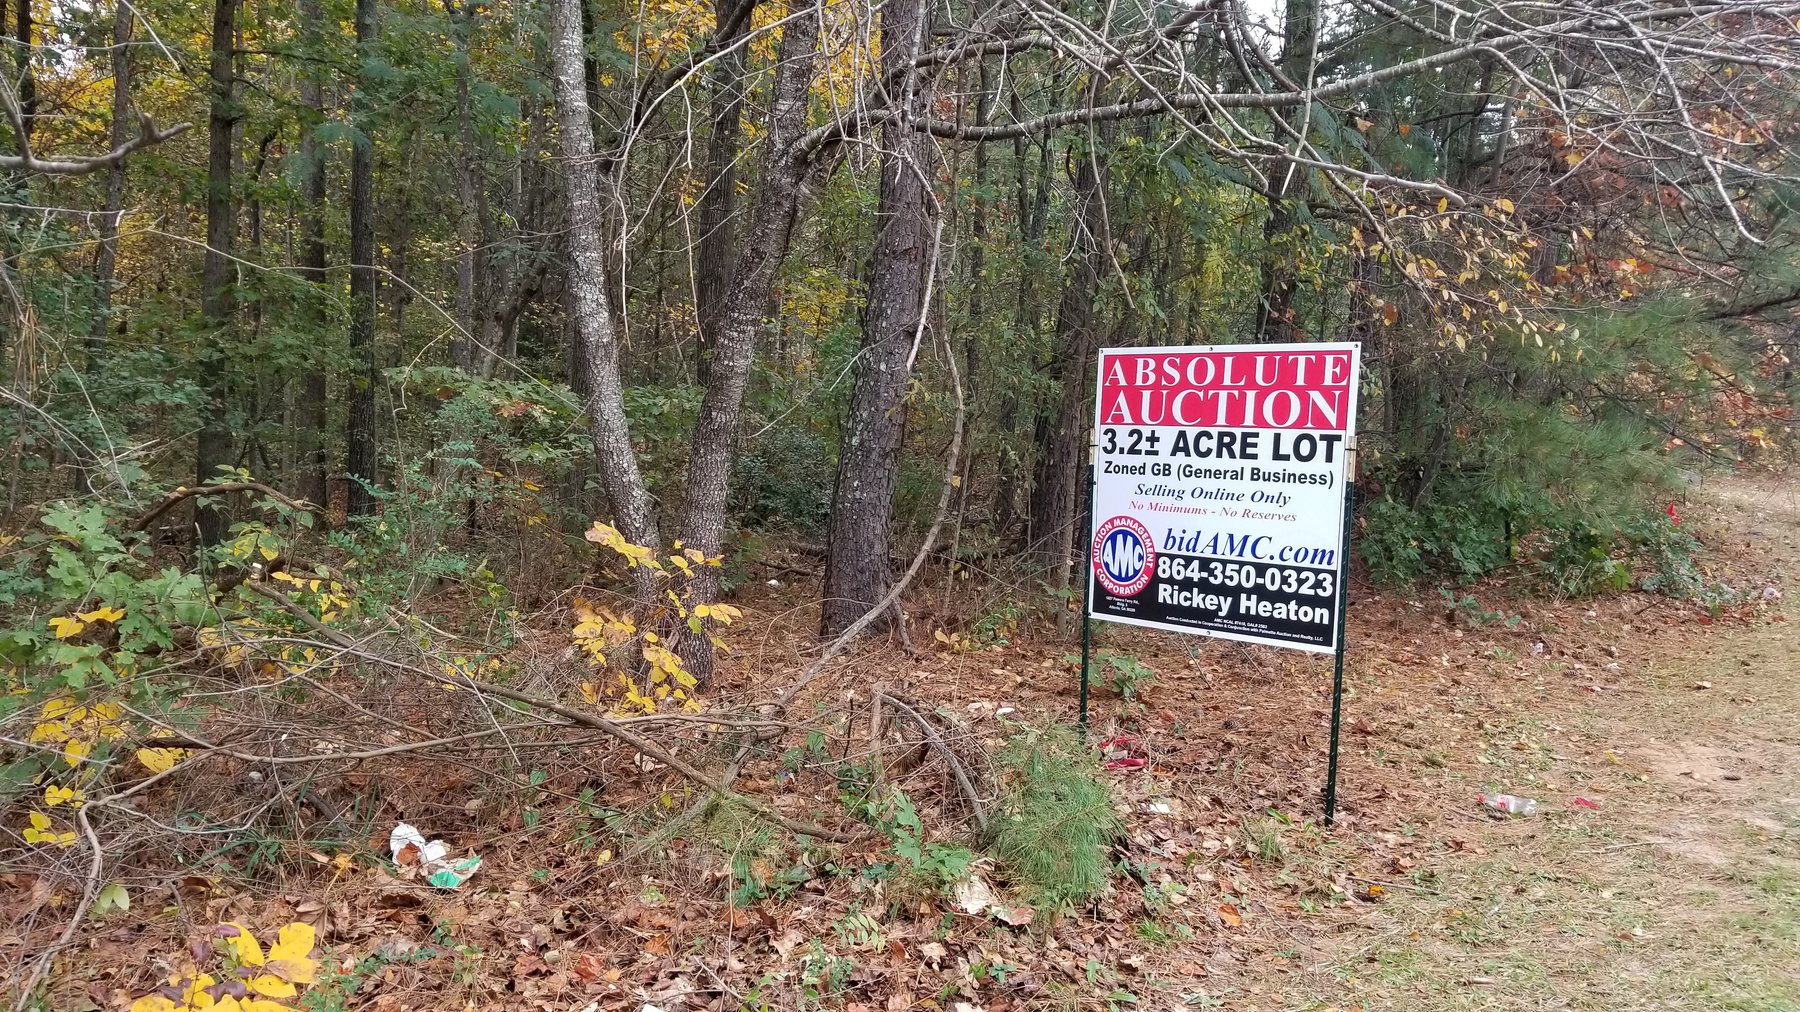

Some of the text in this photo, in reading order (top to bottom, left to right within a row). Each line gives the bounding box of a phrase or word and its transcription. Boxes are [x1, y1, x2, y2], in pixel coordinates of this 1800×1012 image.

[1104, 354, 1349, 387] ABSOLUTE
[1107, 389, 1344, 429] AUCTION
[1102, 428, 1342, 463] 3.2± ACRE LOT
[1103, 460, 1334, 489] Zoned GB (General Business)
[1129, 500, 1146, 511] No
[1146, 501, 1207, 516] Minimums
[1219, 506, 1238, 517] No
[1242, 508, 1297, 522] Reserves
[1134, 483, 1291, 507] Selling Online Only
[1093, 518, 1154, 568] AUCTION MANAGEMENT
[1103, 533, 1144, 578] AMC
[1163, 527, 1335, 566] bidAMC.com
[1096, 568, 1149, 595] CORPORATION
[1157, 556, 1334, 597] 864-350-0323
[1158, 583, 1329, 624] Rickey Heaton
